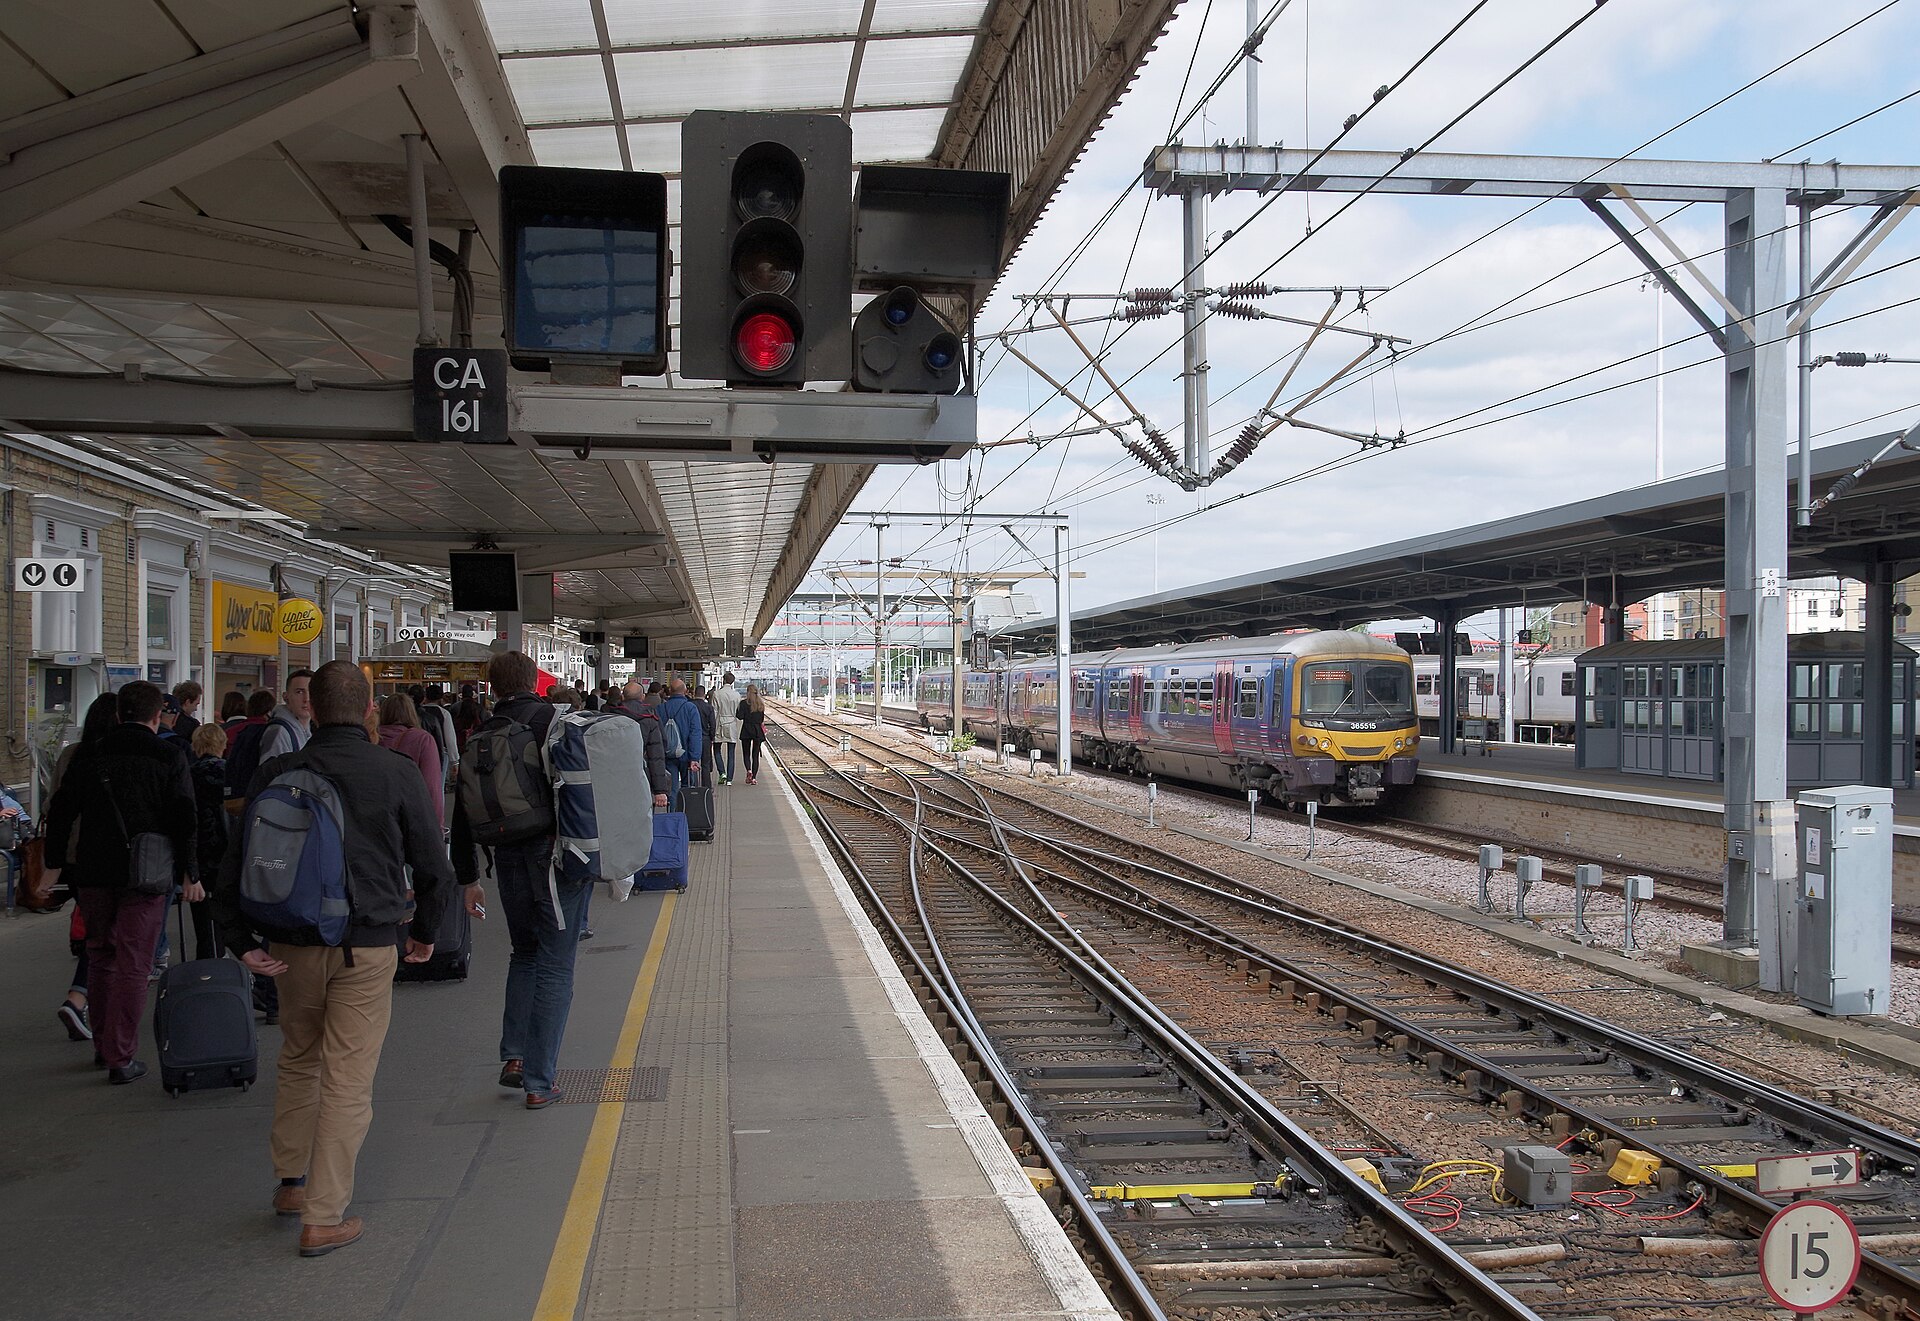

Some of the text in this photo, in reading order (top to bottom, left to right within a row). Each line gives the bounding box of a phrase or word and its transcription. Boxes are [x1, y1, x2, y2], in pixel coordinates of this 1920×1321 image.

[433, 357, 486, 390] CA
[442, 399, 480, 432] 161
[227, 597, 276, 634] Upper Crust
[282, 608, 314, 625] Upper
[282, 619, 312, 634] Crust
[453, 631, 465, 639] Way
[1522, 630, 1530, 640] 4
[408, 640, 458, 655] AMT
[1791, 1231, 1830, 1280] 15
